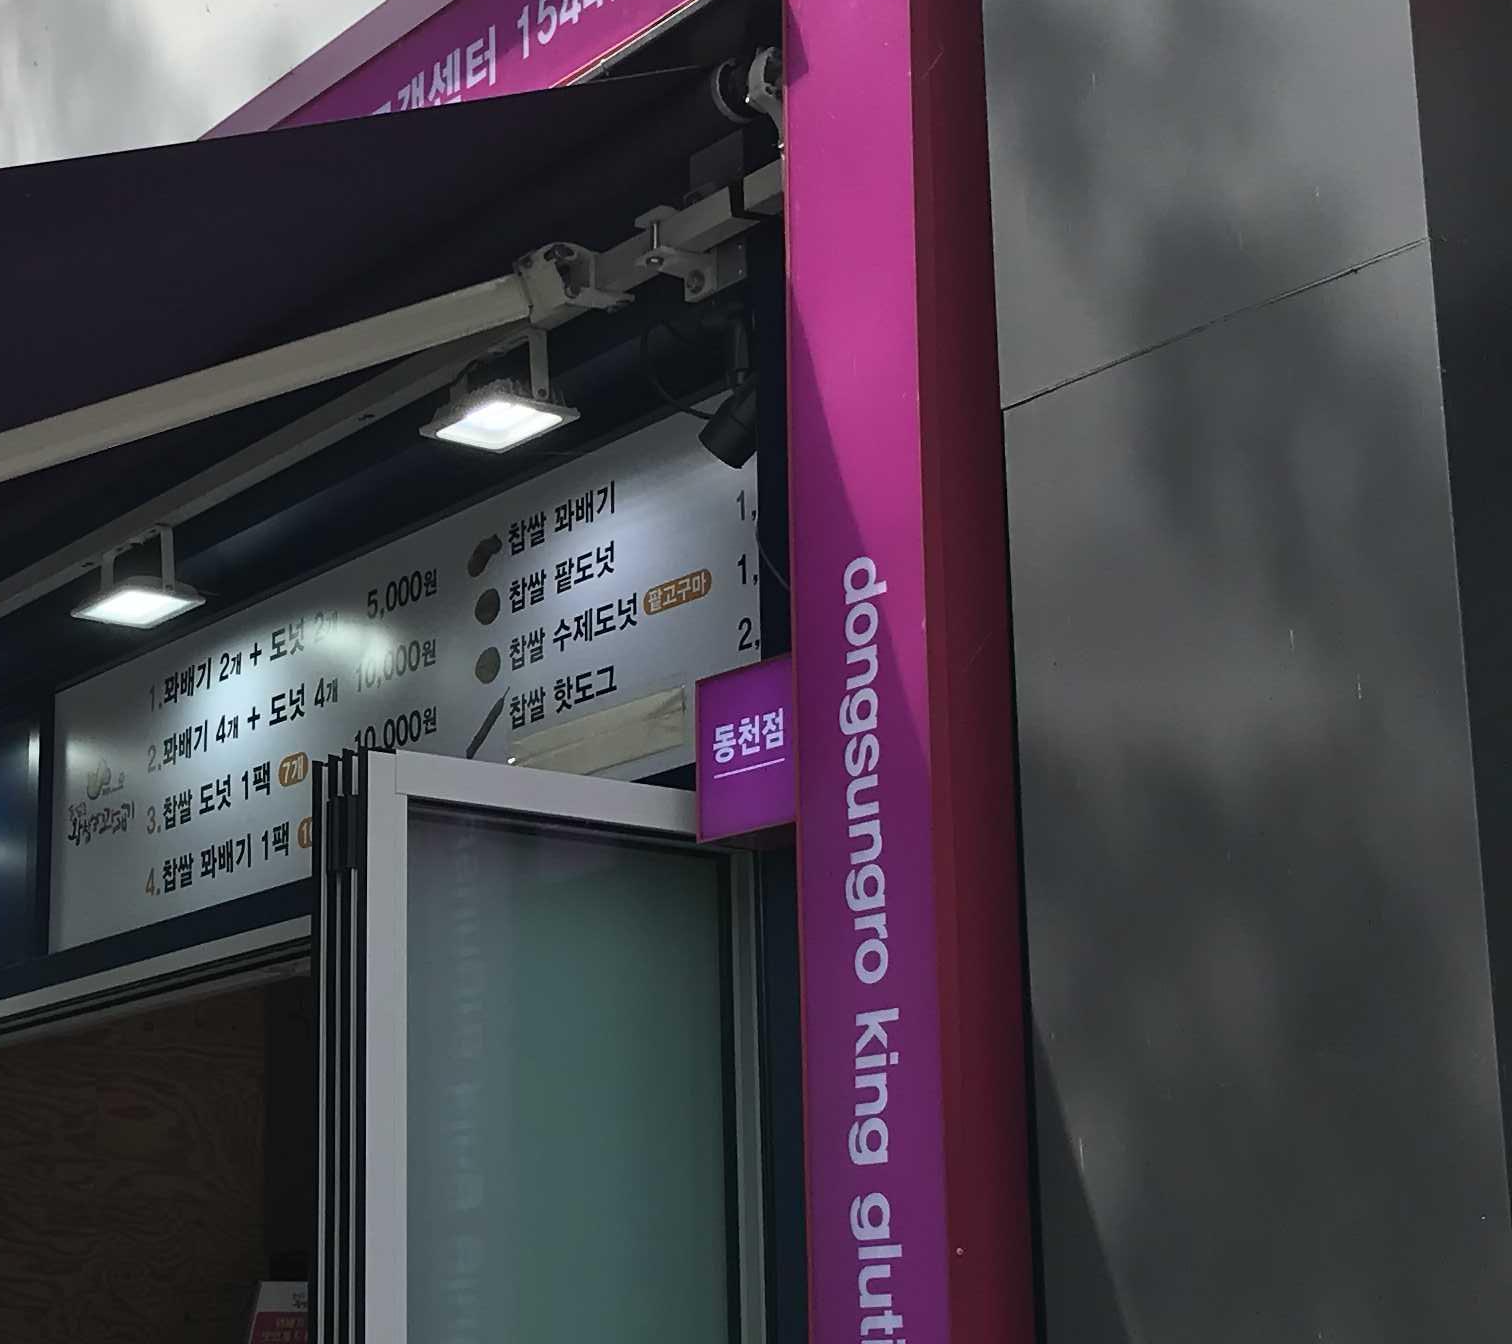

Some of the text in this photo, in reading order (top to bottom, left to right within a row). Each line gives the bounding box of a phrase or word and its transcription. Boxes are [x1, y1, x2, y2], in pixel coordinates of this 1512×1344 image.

[372, 26, 498, 114] 객센터
[508, 510, 546, 556] 찹쌀
[554, 479, 617, 534] 꽈배기
[508, 568, 546, 614] 찹쌀
[553, 539, 617, 594] 팥도넛
[219, 651, 243, 683] 2개
[270, 621, 305, 662] 도넛
[367, 567, 439, 620] 5,000원
[508, 627, 545, 672] 찹쌀
[552, 591, 639, 653] 수제도넛
[215, 713, 240, 745] 4개
[269, 682, 306, 726] 도넛
[314, 677, 339, 708] 4개
[354, 638, 437, 694] 10,000원
[353, 705, 438, 750] 10000원
[508, 664, 618, 731] 찹쌀 핫도그
[711, 706, 786, 766] 동천점
[839, 555, 889, 984] dongsungro
[199, 774, 233, 814] 도넛
[241, 760, 273, 801] 1팩
[199, 837, 253, 881] 꽈배기
[261, 820, 290, 858] 1팩
[848, 1006, 899, 1165] king
